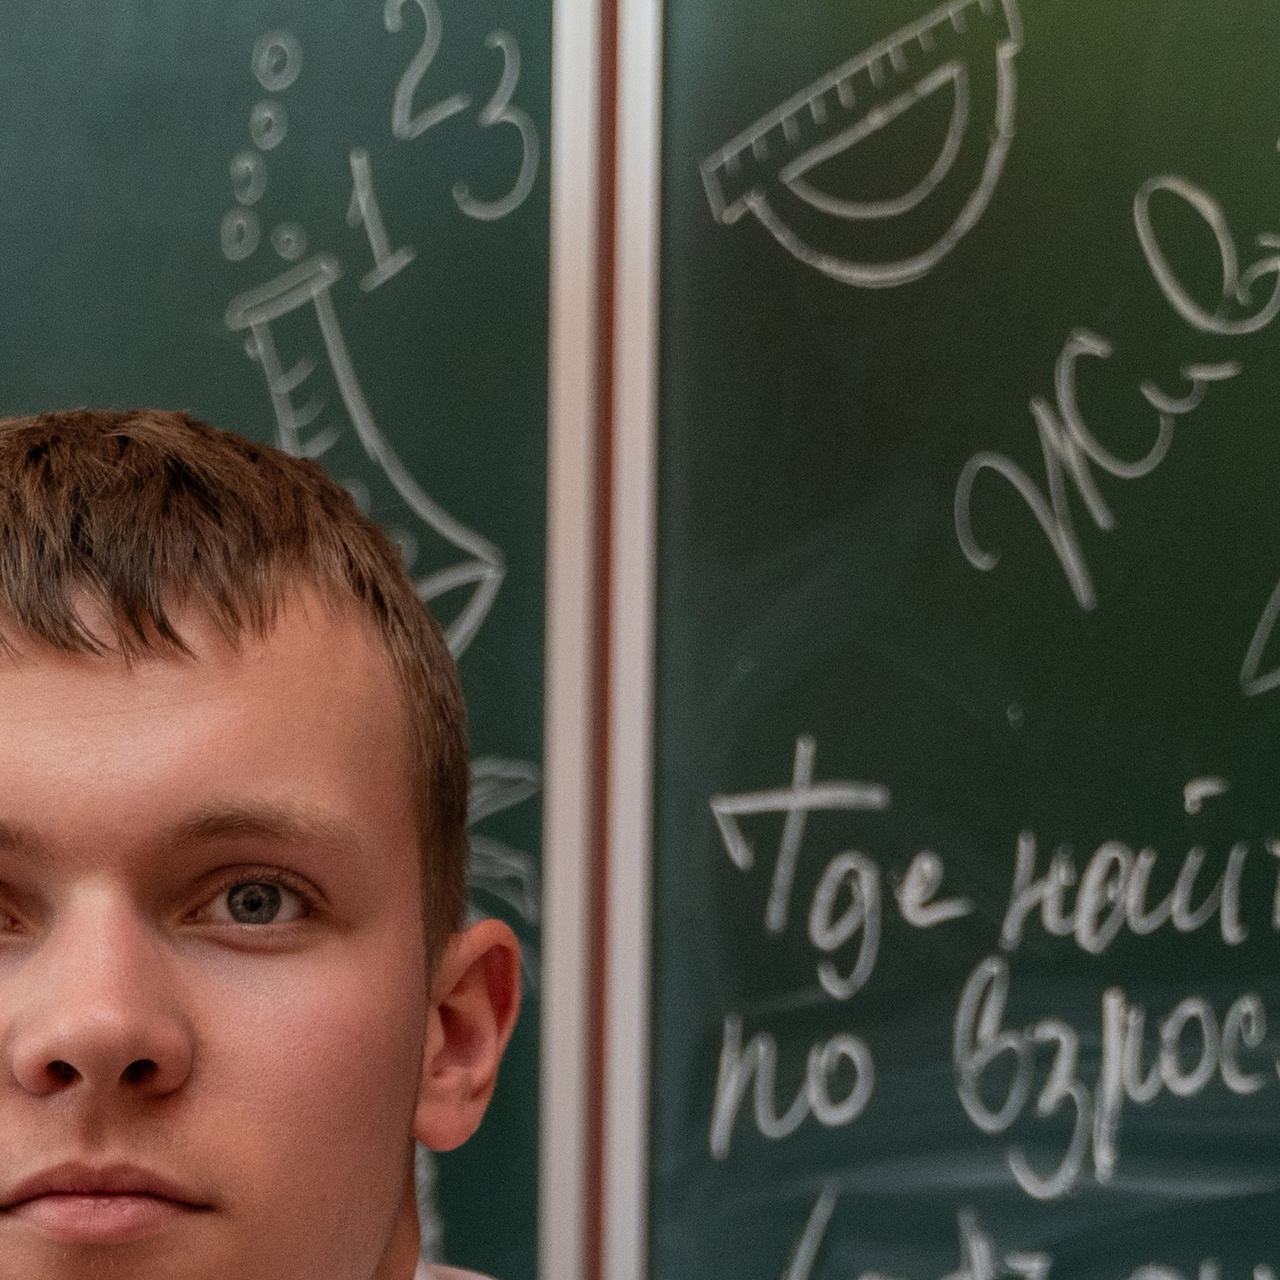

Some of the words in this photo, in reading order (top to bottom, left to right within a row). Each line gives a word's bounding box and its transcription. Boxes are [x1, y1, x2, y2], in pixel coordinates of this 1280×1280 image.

[1000, 775, 1280, 953] най
[709, 1012, 876, 1161] по
[952, 954, 1280, 1200] взрос
